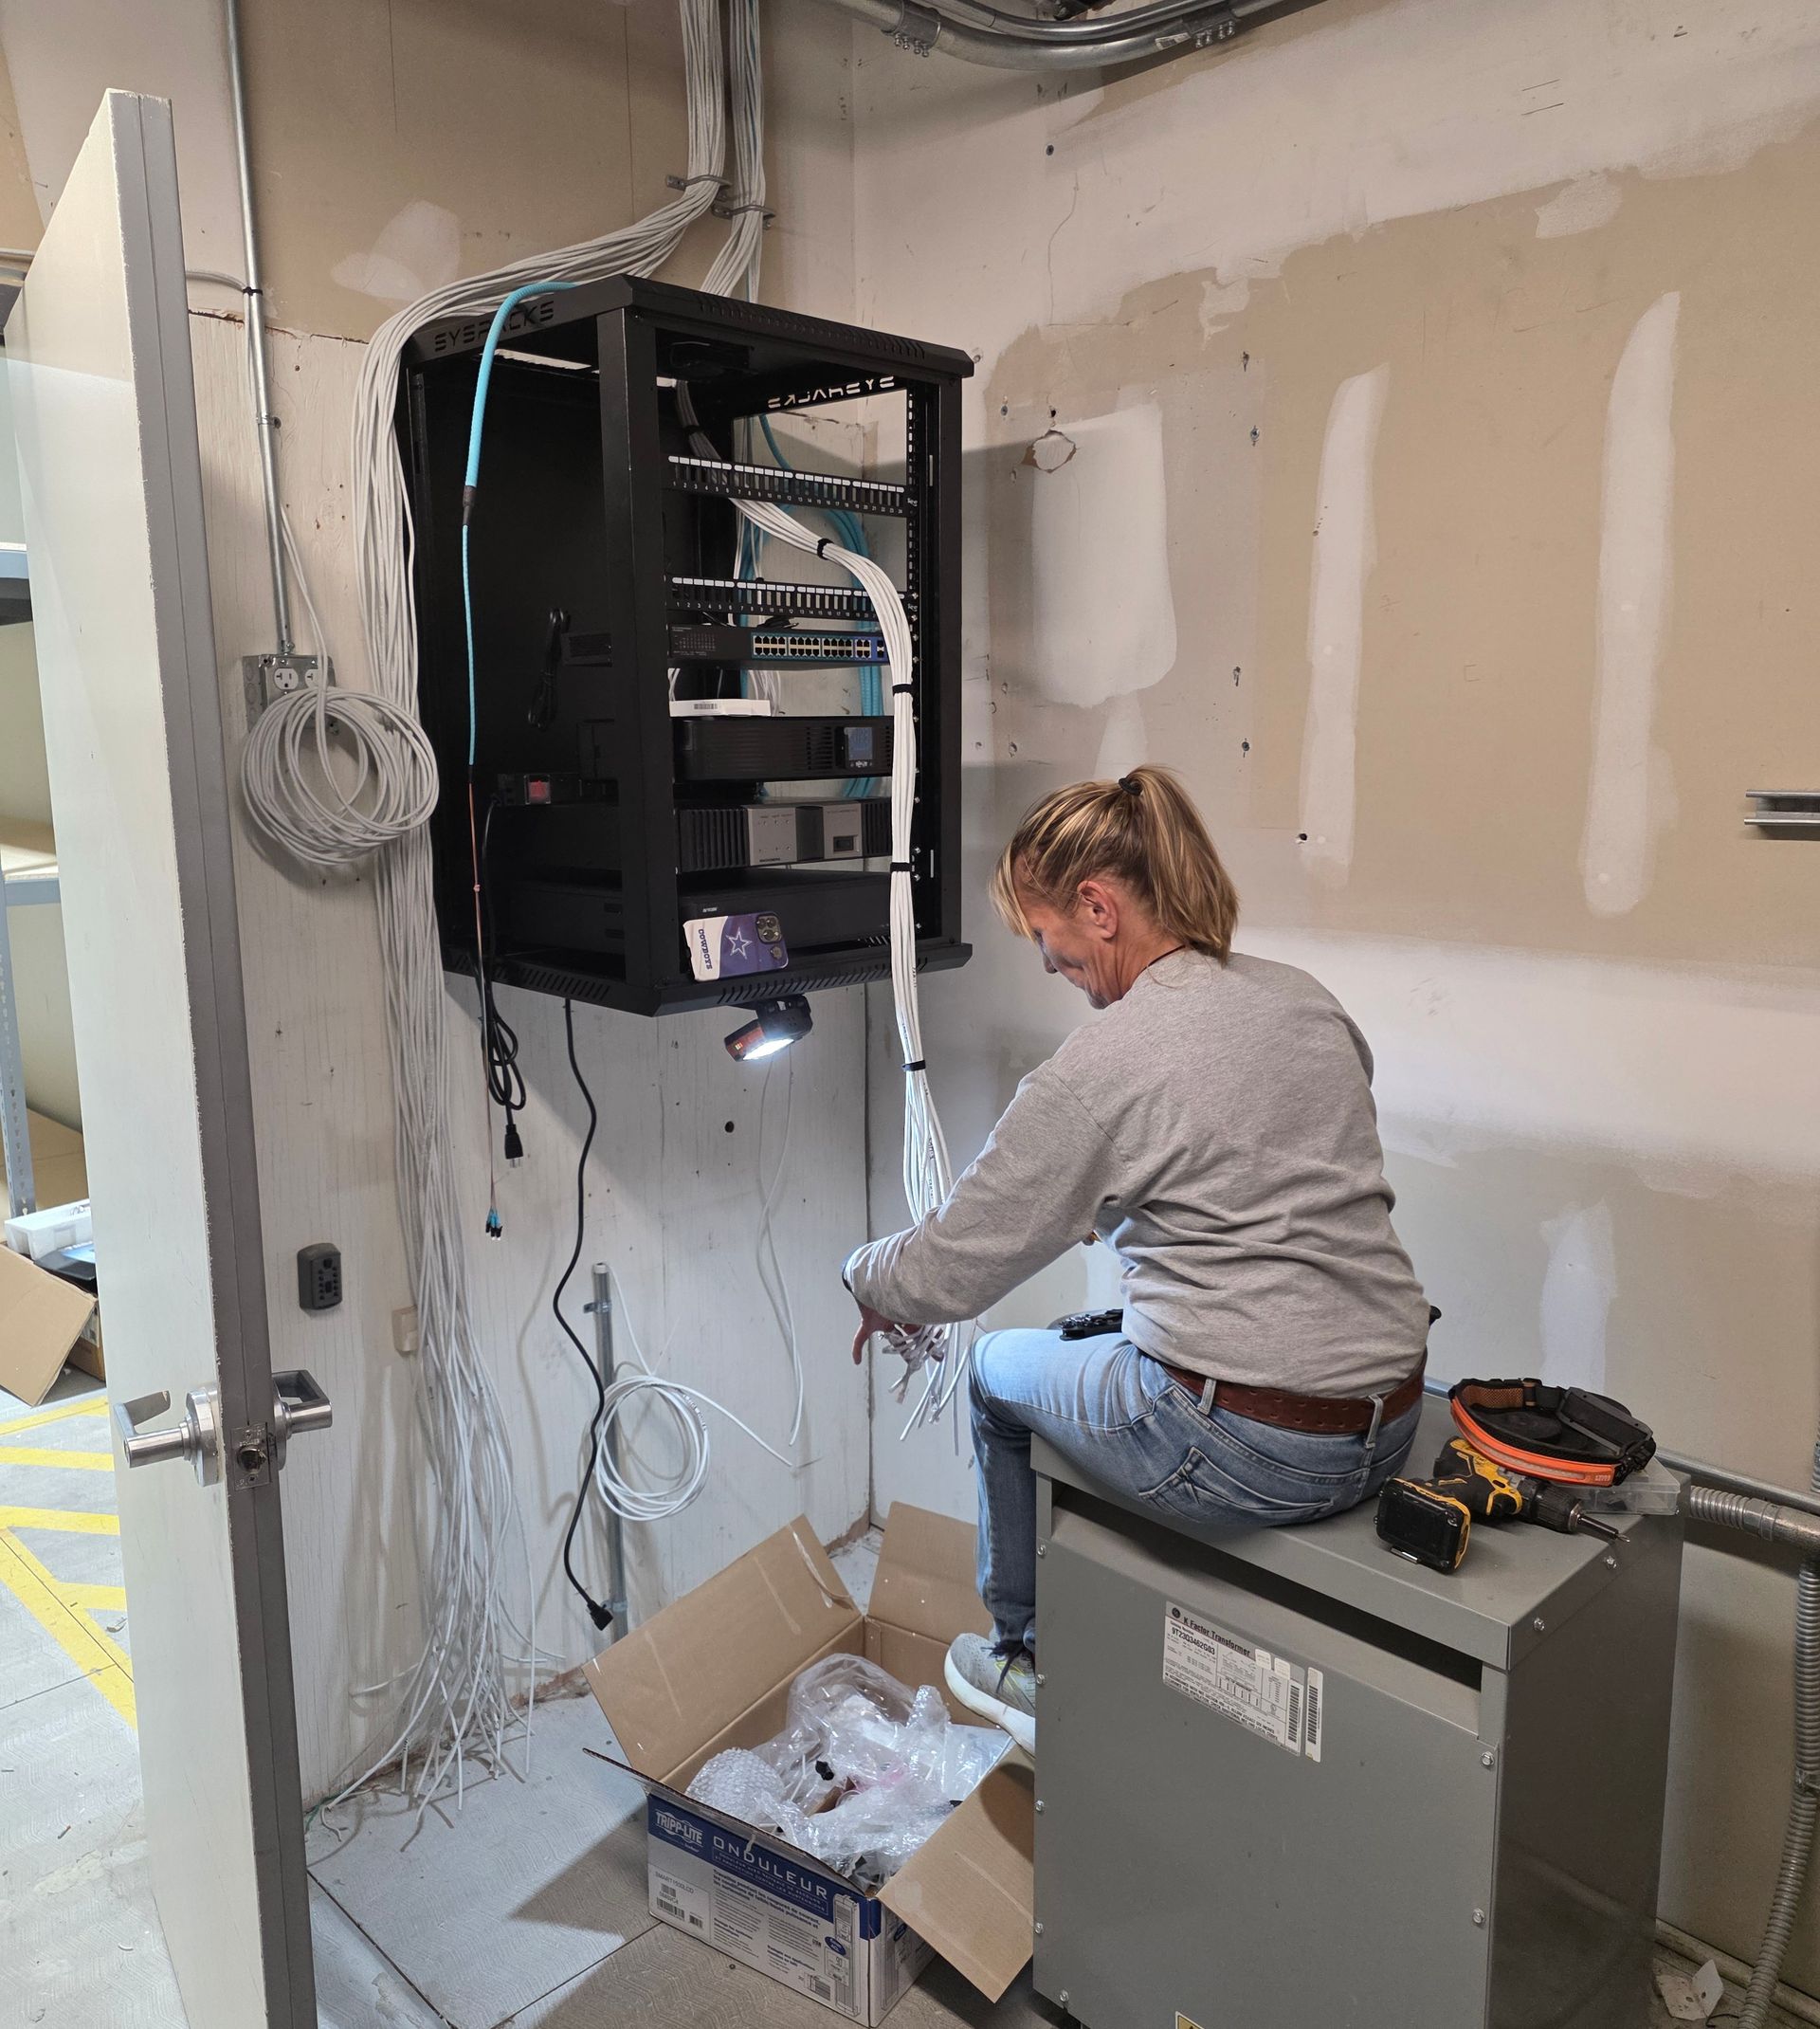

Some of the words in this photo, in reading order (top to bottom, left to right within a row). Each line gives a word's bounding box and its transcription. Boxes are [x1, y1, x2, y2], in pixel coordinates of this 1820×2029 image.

[698, 929, 713, 969] COWBOYS
[1190, 1618, 1210, 1636] Factor
[1210, 1630, 1250, 1656] Transformer
[655, 1811, 702, 1845] TRIPP-LITE
[714, 1836, 828, 1899] ONDULEUR
